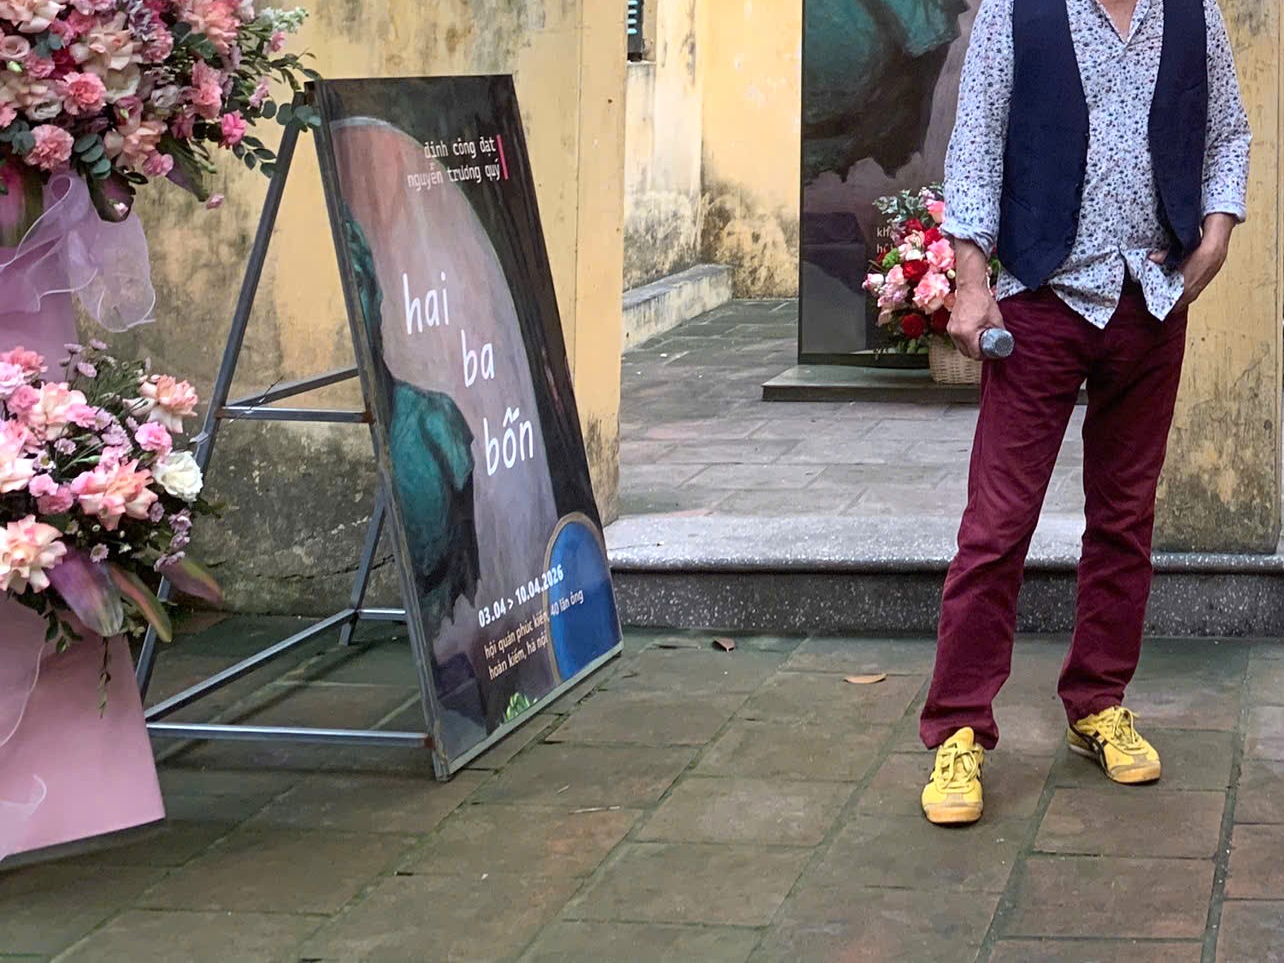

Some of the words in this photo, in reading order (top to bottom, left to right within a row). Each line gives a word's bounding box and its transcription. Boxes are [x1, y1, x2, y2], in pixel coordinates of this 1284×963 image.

[407, 163, 444, 191] nguyễn
[447, 164, 481, 184] trương
[484, 158, 501, 181] quý
[453, 138, 477, 158] công
[480, 137, 496, 156] đạt
[403, 272, 449, 335] hai
[461, 329, 495, 388] ba
[478, 597, 506, 628] 03.04
[515, 564, 564, 605] 10.04.2026
[484, 640, 497, 660] hội
[550, 602, 560, 616] 40
